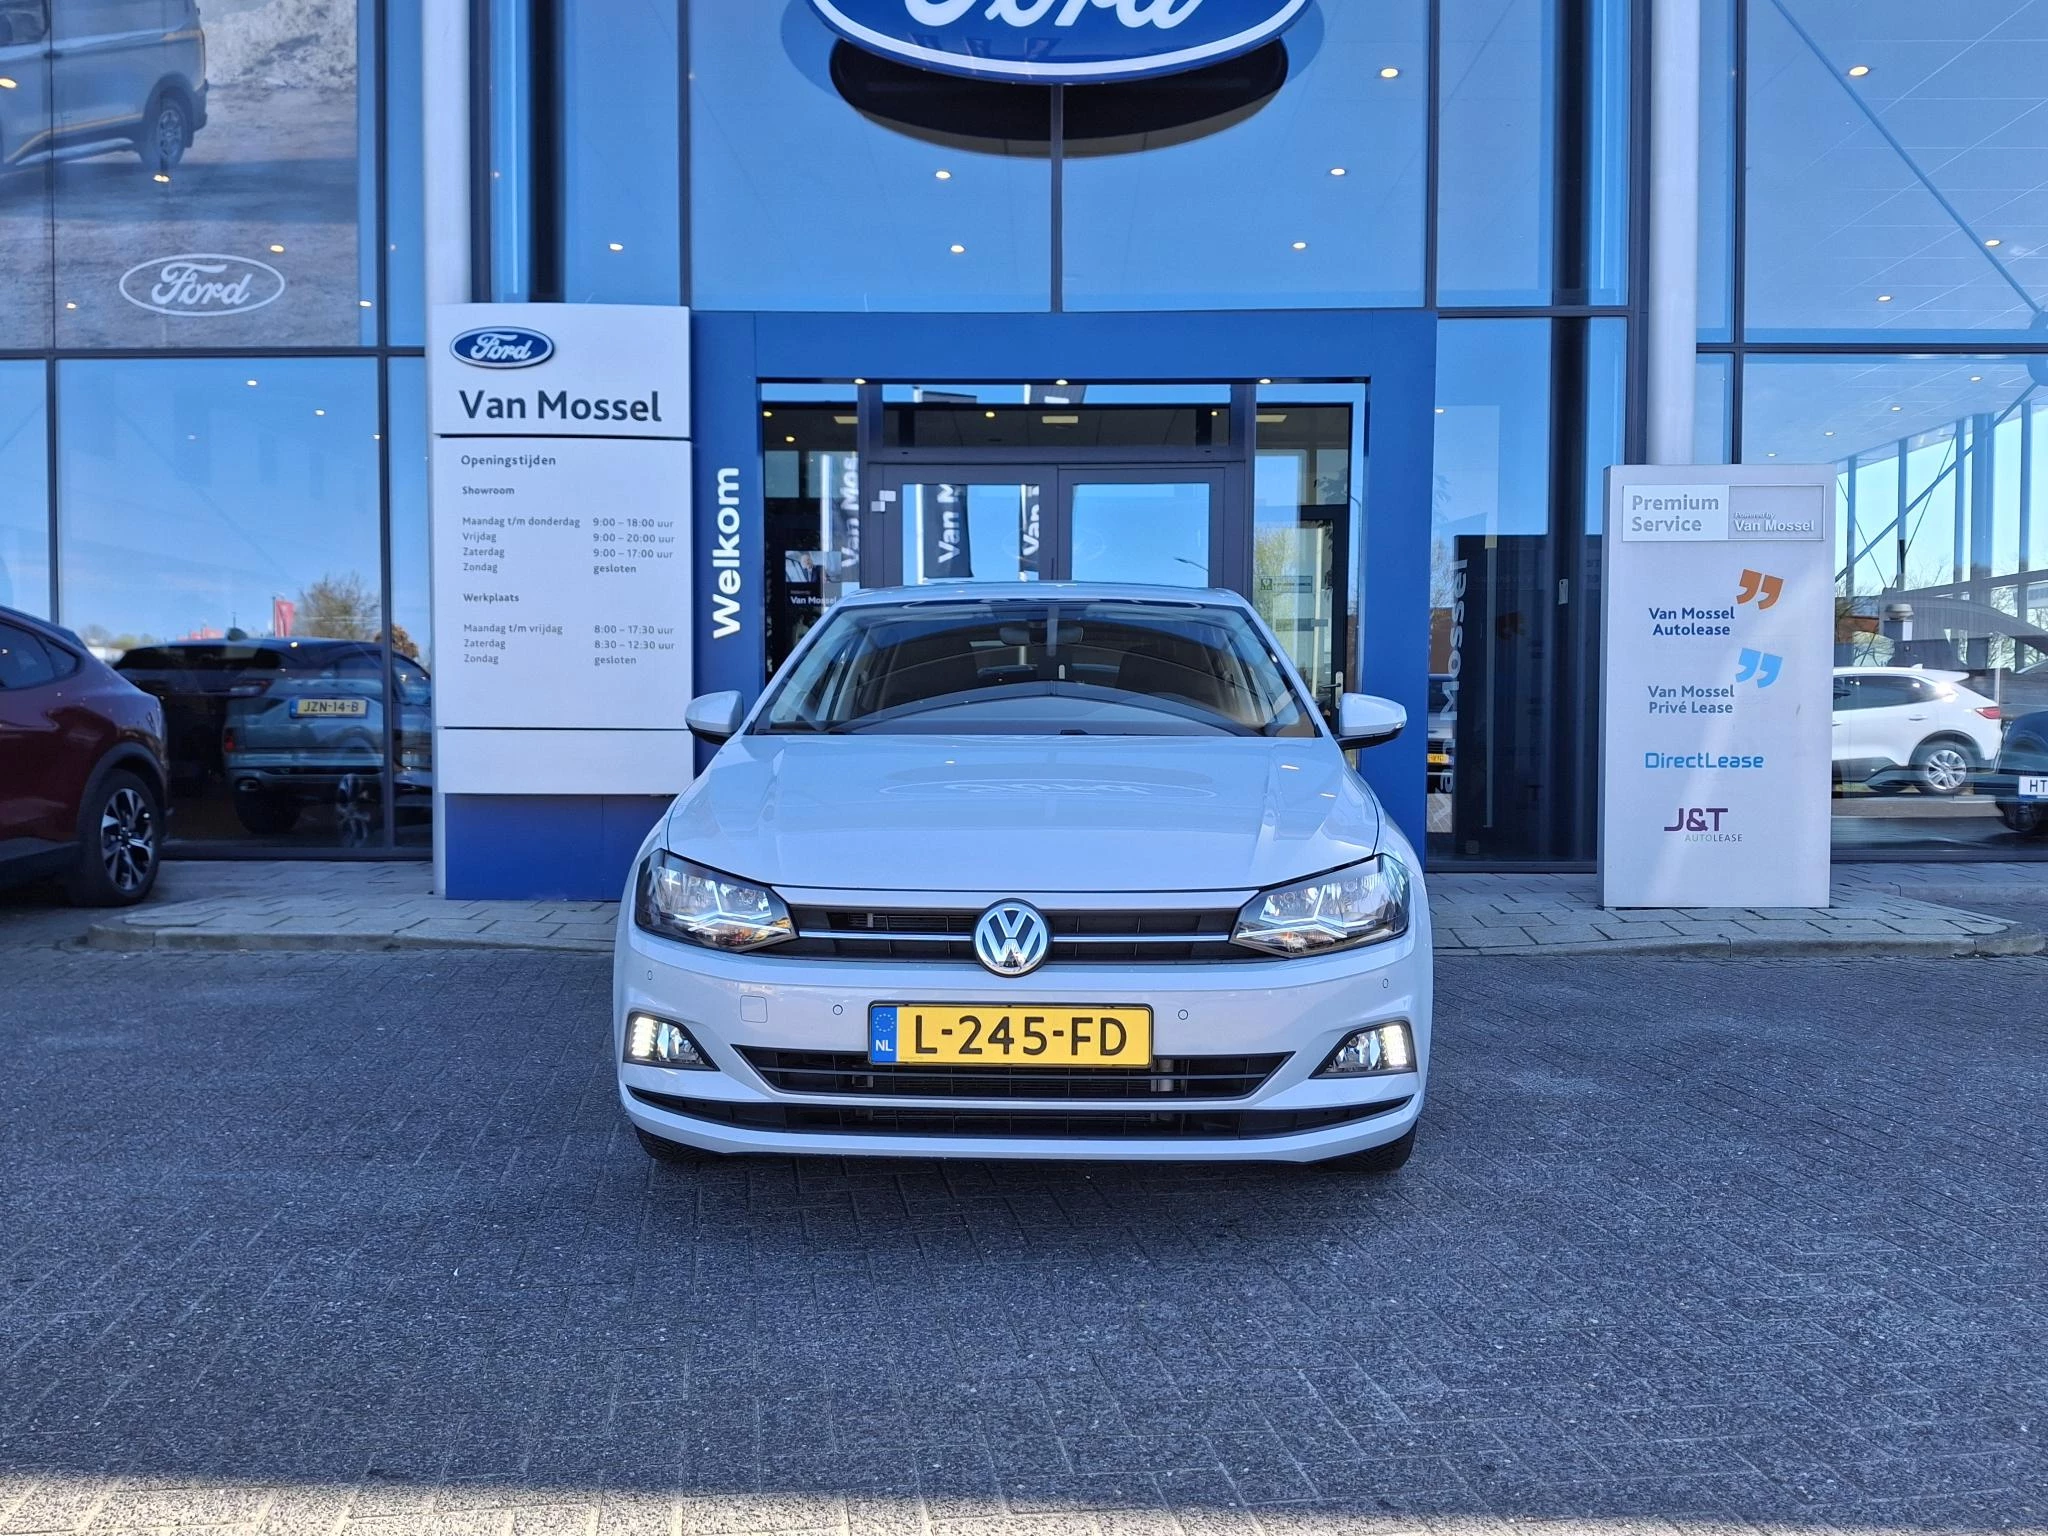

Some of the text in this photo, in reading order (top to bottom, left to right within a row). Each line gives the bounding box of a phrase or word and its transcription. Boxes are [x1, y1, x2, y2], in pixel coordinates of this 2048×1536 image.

[905, 0, 1203, 29] or
[151, 262, 253, 305] Ford
[470, 333, 533, 361] Ford
[459, 390, 662, 422] Van Mossel
[461, 455, 556, 468] Openingstijden
[462, 486, 515, 496] Showroom
[1632, 494, 1719, 510] Premium
[462, 517, 505, 527] Maandag
[507, 517, 526, 526] t/m
[528, 517, 580, 528] donderdag
[593, 518, 616, 527] 9:00
[626, 518, 655, 528] 18:00
[1632, 516, 1702, 532] Service
[1734, 519, 1815, 532] Van Mossel
[462, 532, 496, 543] Vrijdag
[593, 533, 616, 542] 9:00
[626, 534, 656, 543] 20:00
[938, 511, 960, 563] Van
[463, 547, 505, 558] Zaterdag
[593, 549, 616, 558] 9:00
[626, 549, 654, 559] 17:00
[657, 551, 673, 559] uur
[712, 467, 742, 639] Welkom
[463, 562, 636, 574] Zondag gesloten
[463, 593, 519, 604] Werkplaats
[791, 597, 806, 605] Van
[1649, 606, 1735, 619] Van Mossel
[464, 623, 506, 634] Maandag
[509, 624, 527, 633] t/m
[529, 624, 563, 635] vrijdag
[594, 625, 617, 634] 8:00
[628, 625, 655, 634] 17:30
[1653, 624, 1730, 636] Autolease
[464, 639, 506, 650] Zaterdag
[594, 640, 617, 649] 8:30
[628, 640, 655, 650] 12:30
[658, 642, 675, 650] uur
[1439, 559, 1468, 721] Mossel
[464, 654, 636, 666] Zondag gesloten
[1648, 685, 1734, 698] Van Mossel
[303, 700, 359, 712] JZN-14-B
[1649, 701, 1733, 713] Privé Lease
[1645, 753, 1764, 768] DirectLease
[1664, 808, 1728, 831] J&T
[1685, 834, 1743, 842] AUTOLEASE
[915, 1015, 1127, 1055] L-245-FD
[875, 1039, 893, 1052] NL
